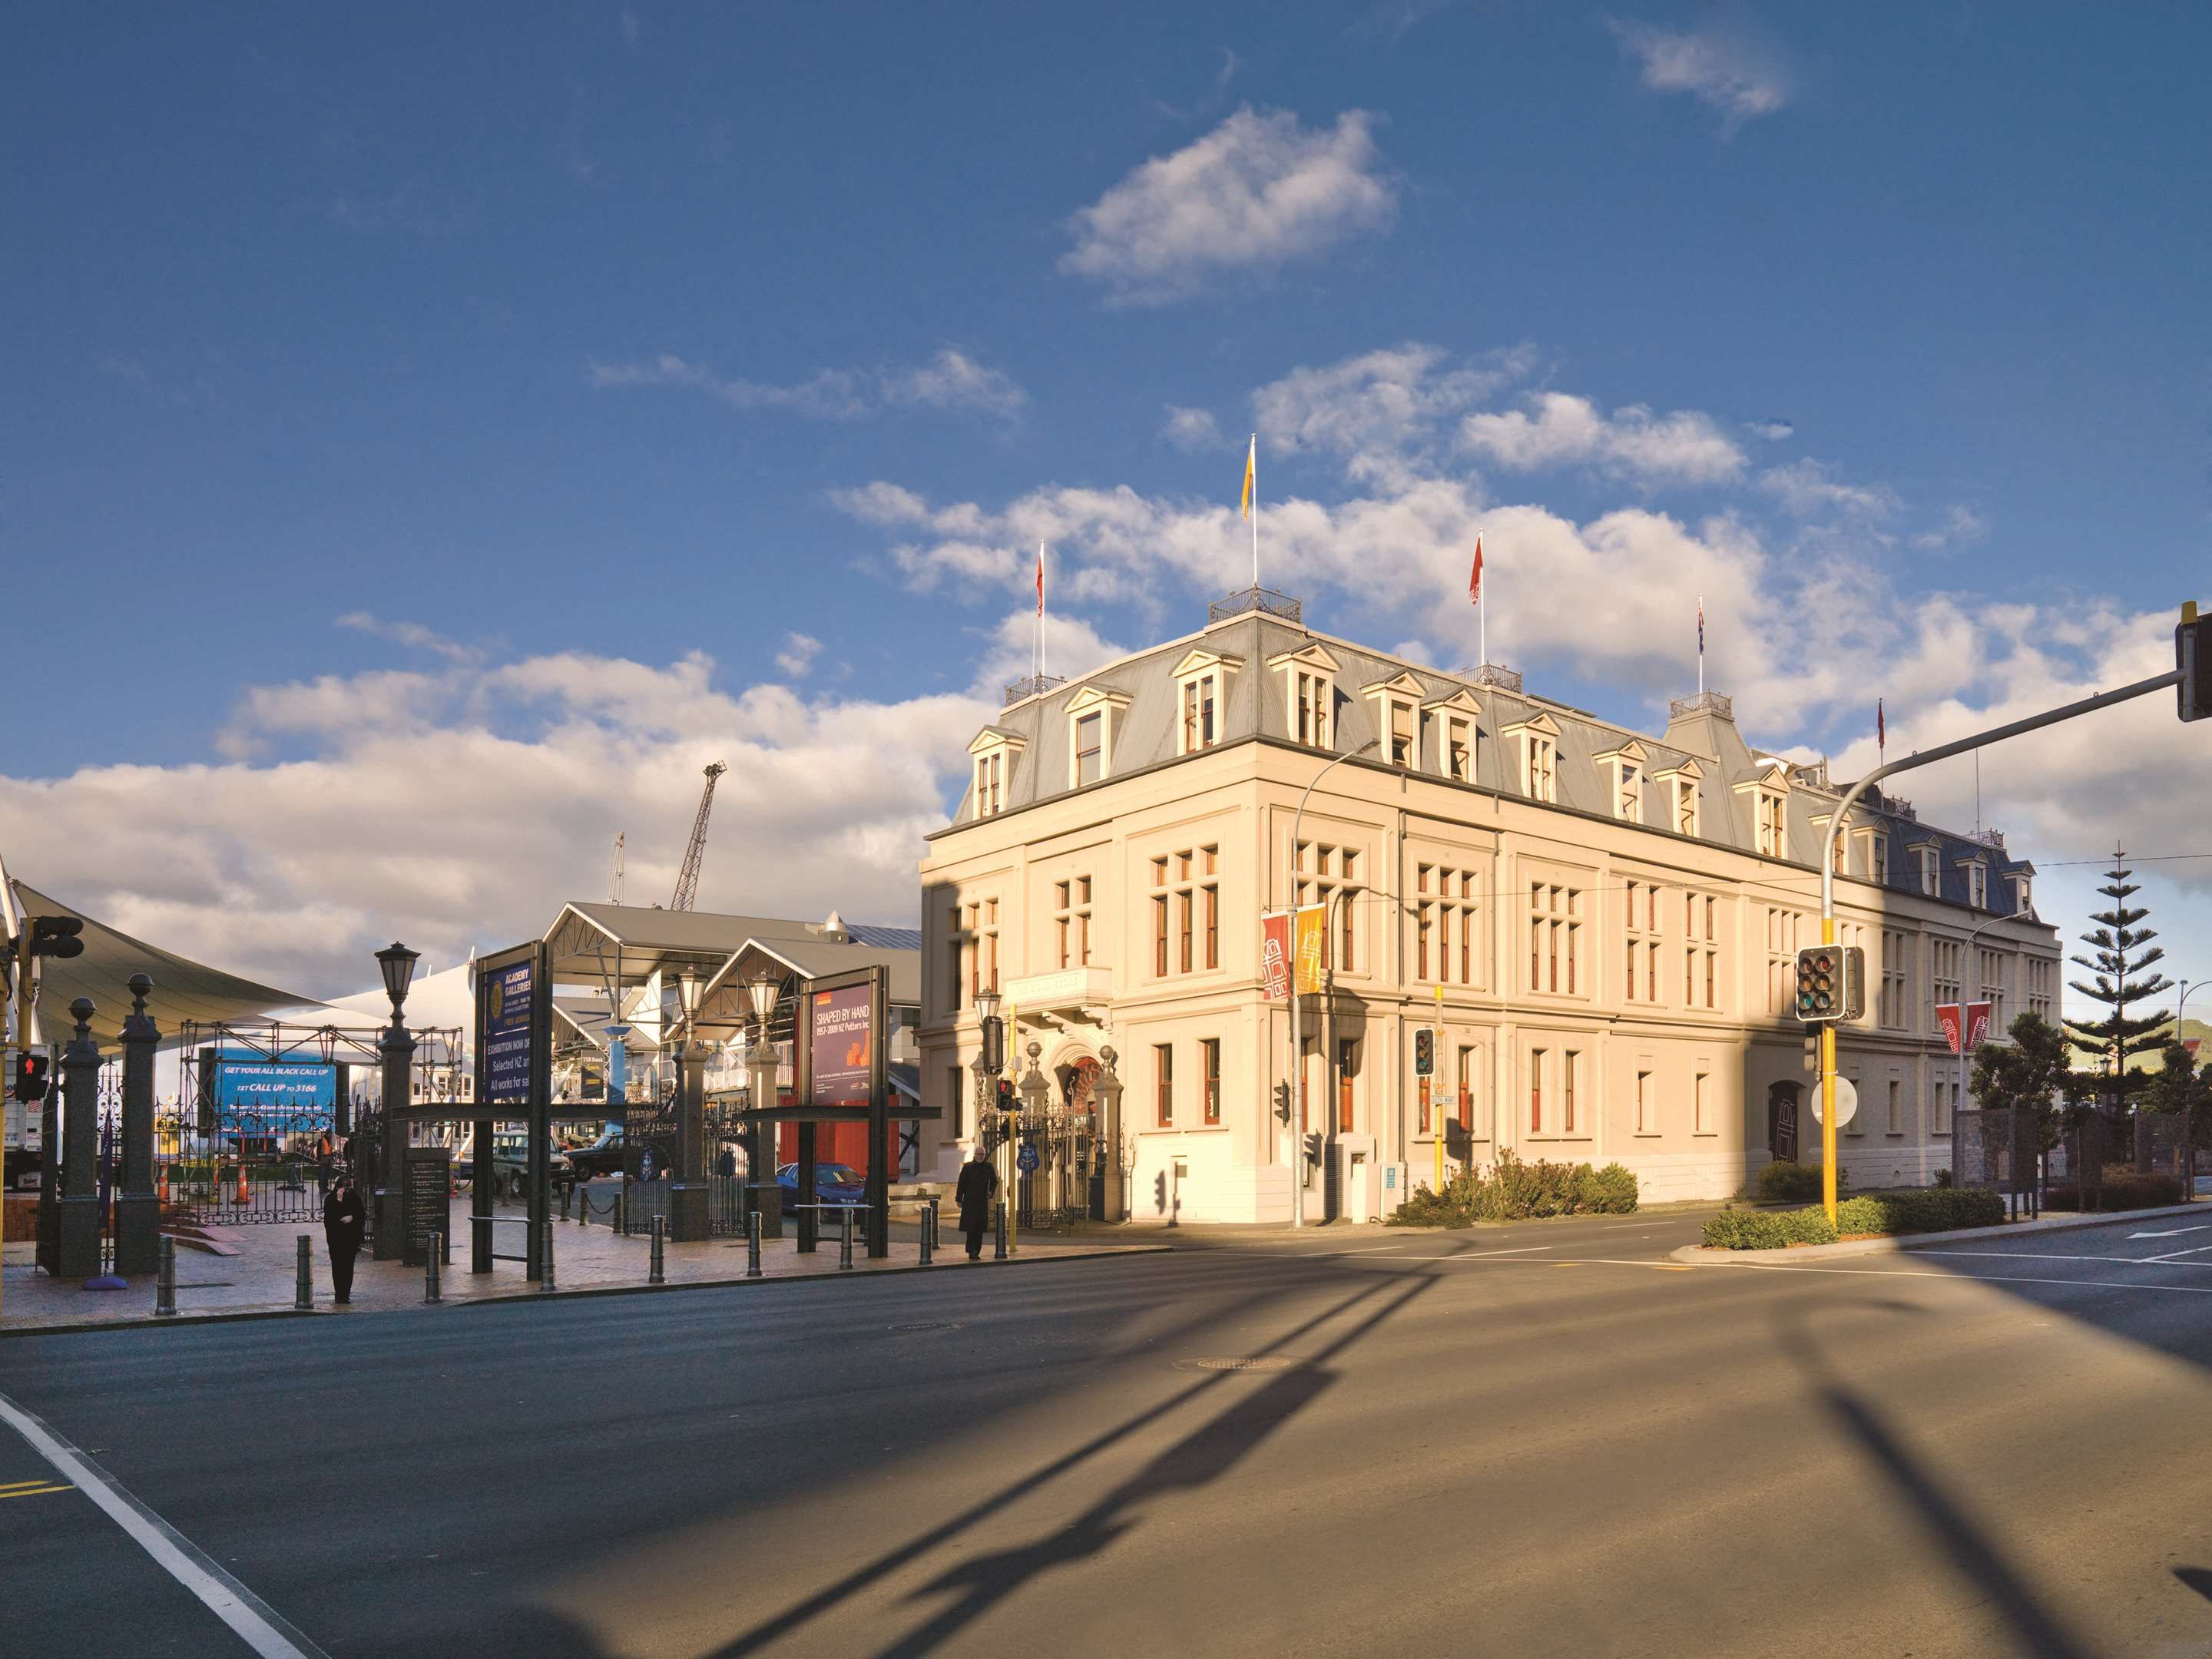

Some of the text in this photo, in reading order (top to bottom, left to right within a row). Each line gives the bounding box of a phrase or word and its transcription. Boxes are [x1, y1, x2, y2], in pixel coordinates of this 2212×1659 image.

[505, 968, 529, 984] ACADEMY
[505, 979, 531, 997] GALLERIES
[816, 1005, 869, 1025] SHAPED BY HAND
[816, 1025, 838, 1035] 1957-2009
[839, 1023, 845, 1032] NZ
[845, 1021, 862, 1031] Potters
[488, 1041, 512, 1055] EXHIBITION
[512, 1038, 524, 1051] NOW
[276, 1067, 299, 1075] BLACK
[492, 1058, 514, 1072] Selected
[515, 1056, 522, 1068] NZ
[249, 1084, 271, 1092] CALL
[273, 1084, 286, 1092] UP
[498, 1077, 512, 1089] works
